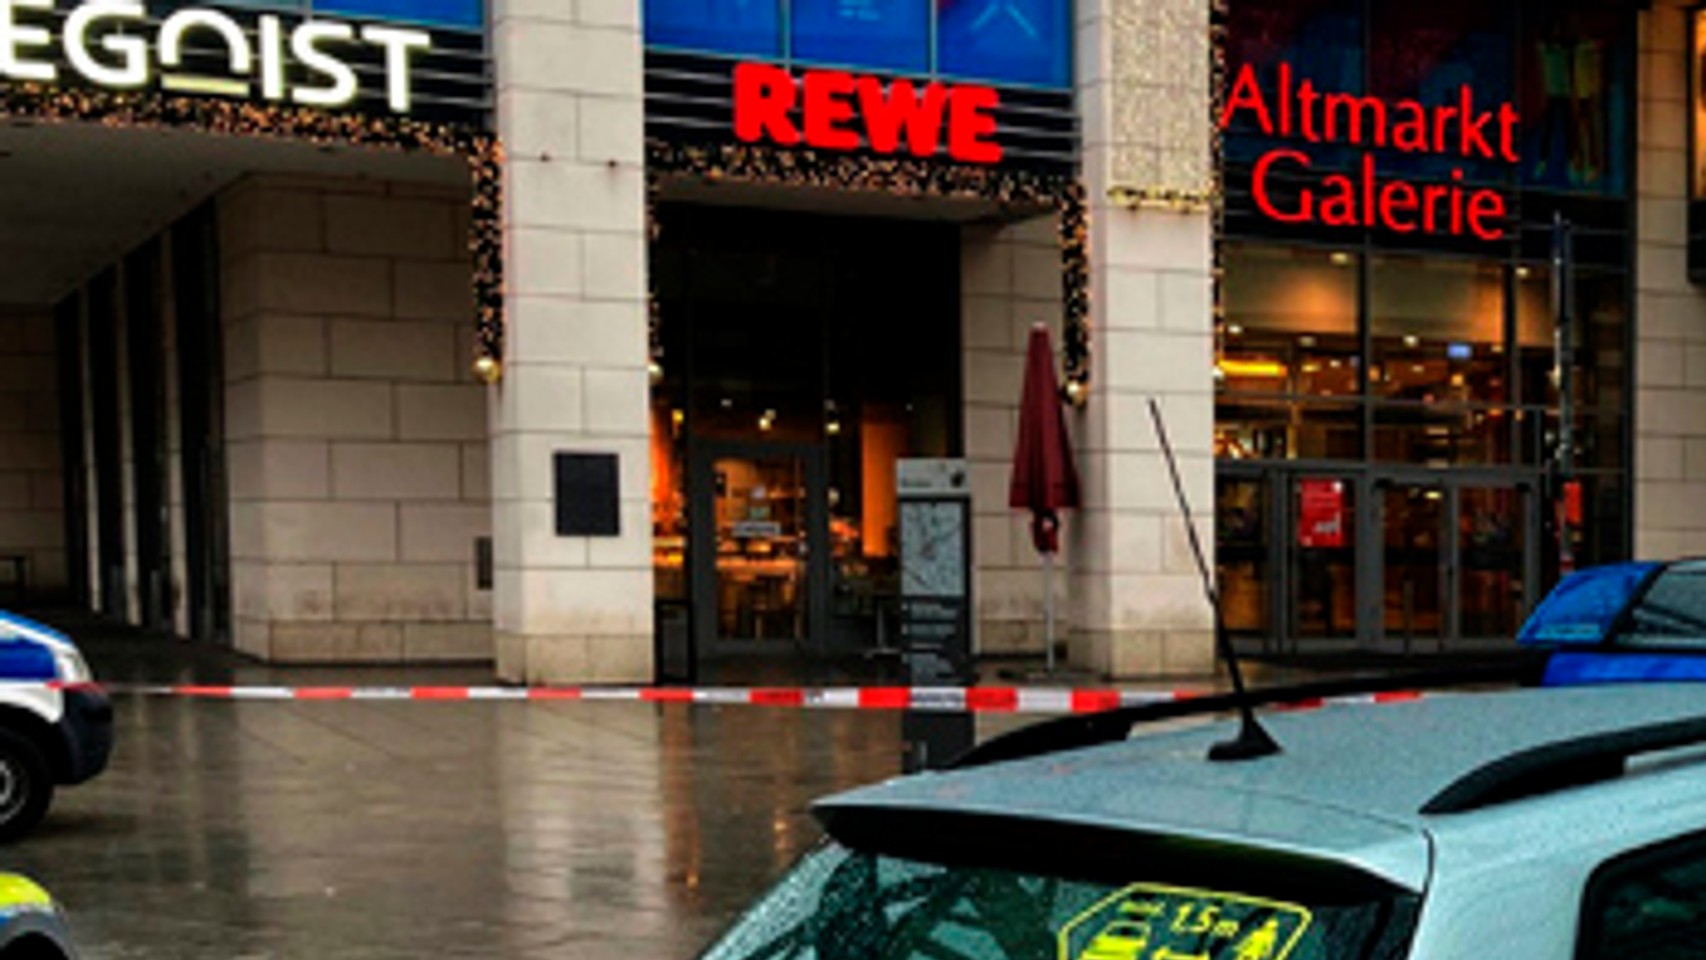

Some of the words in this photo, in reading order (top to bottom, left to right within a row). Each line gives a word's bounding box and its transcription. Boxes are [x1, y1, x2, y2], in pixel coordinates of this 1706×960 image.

[0, 0, 430, 112] EGOIST
[733, 62, 1004, 164] REWE
[1220, 60, 1520, 164] Altmarkt
[1251, 147, 1505, 241] Galerie
